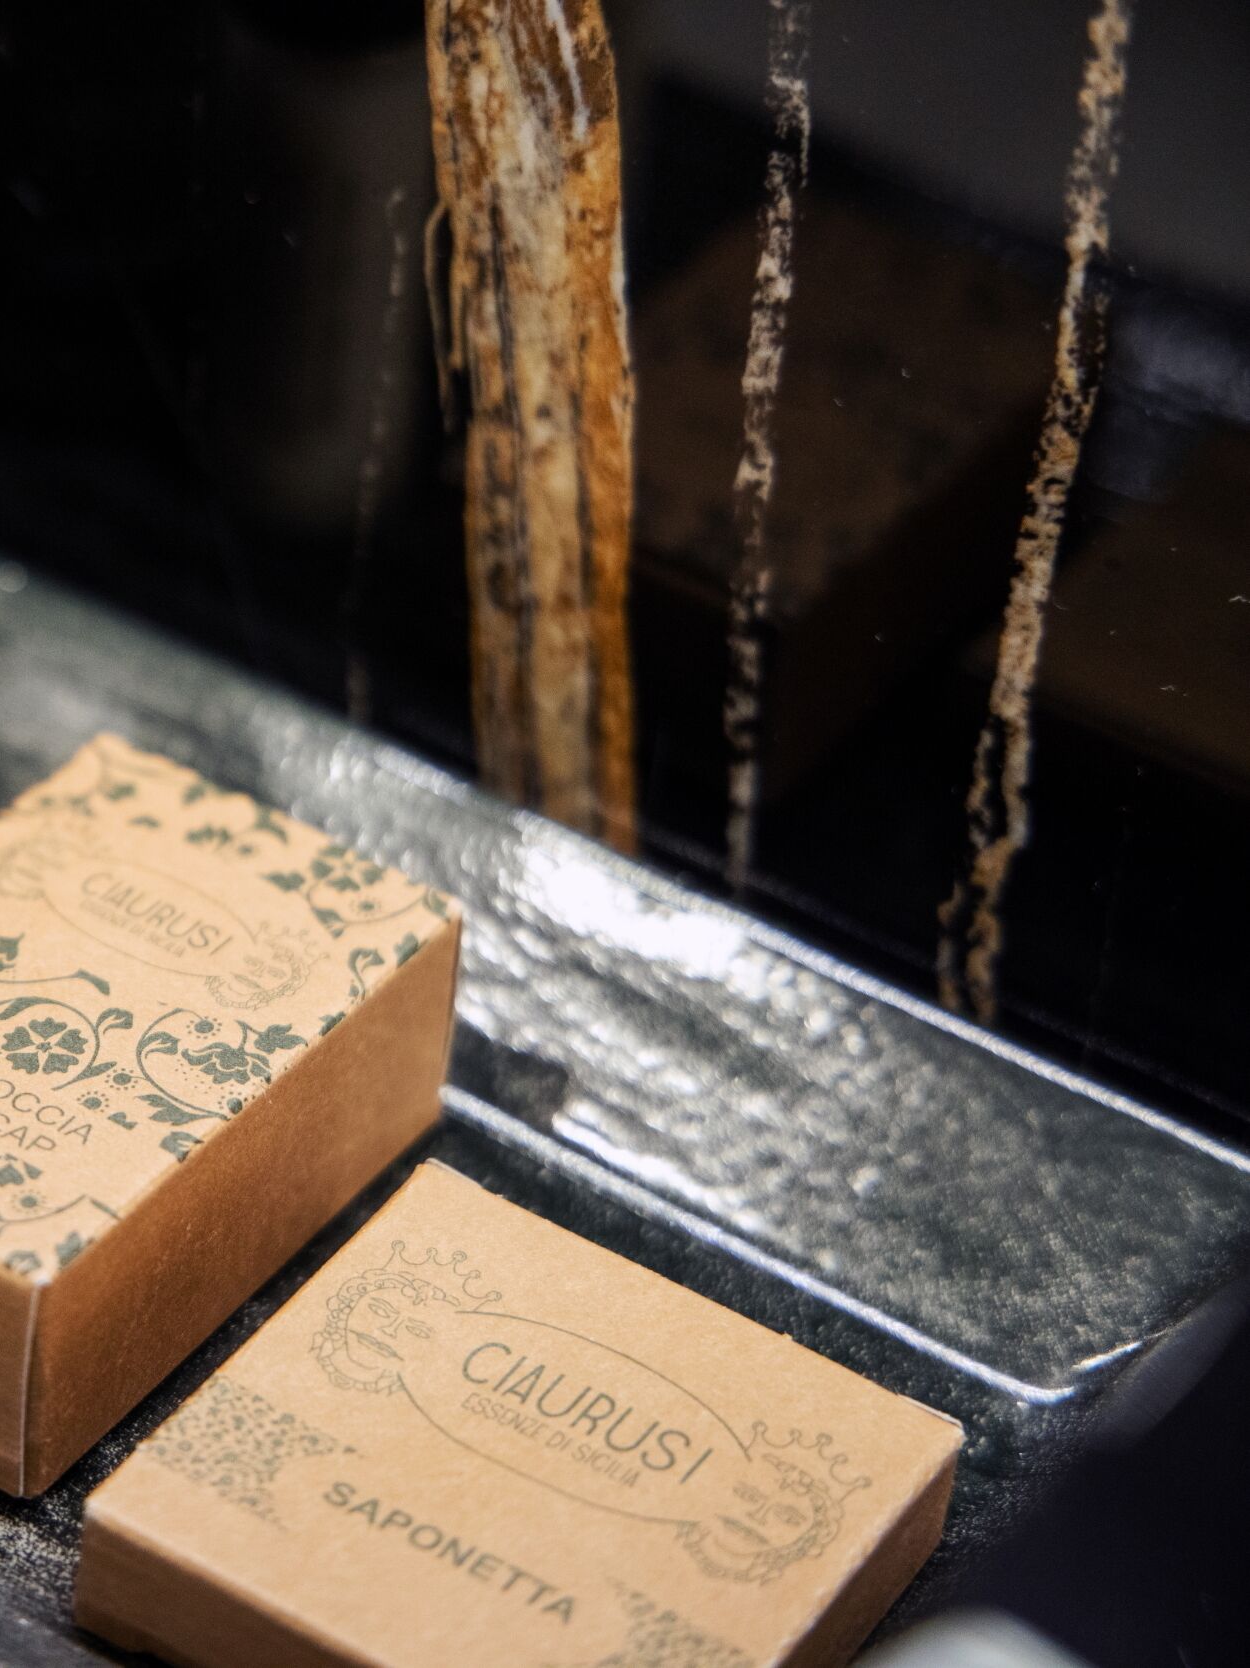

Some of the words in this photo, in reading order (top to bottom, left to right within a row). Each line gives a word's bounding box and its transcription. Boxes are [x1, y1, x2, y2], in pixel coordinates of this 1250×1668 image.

[80, 871, 234, 958] CIAURUSI
[459, 1390, 544, 1440] ESSENZE
[546, 1428, 570, 1453] DI
[570, 1442, 642, 1490] SICILIA
[461, 1341, 715, 1485] CIAURUSI
[322, 1480, 578, 1626] SAPONETTA
